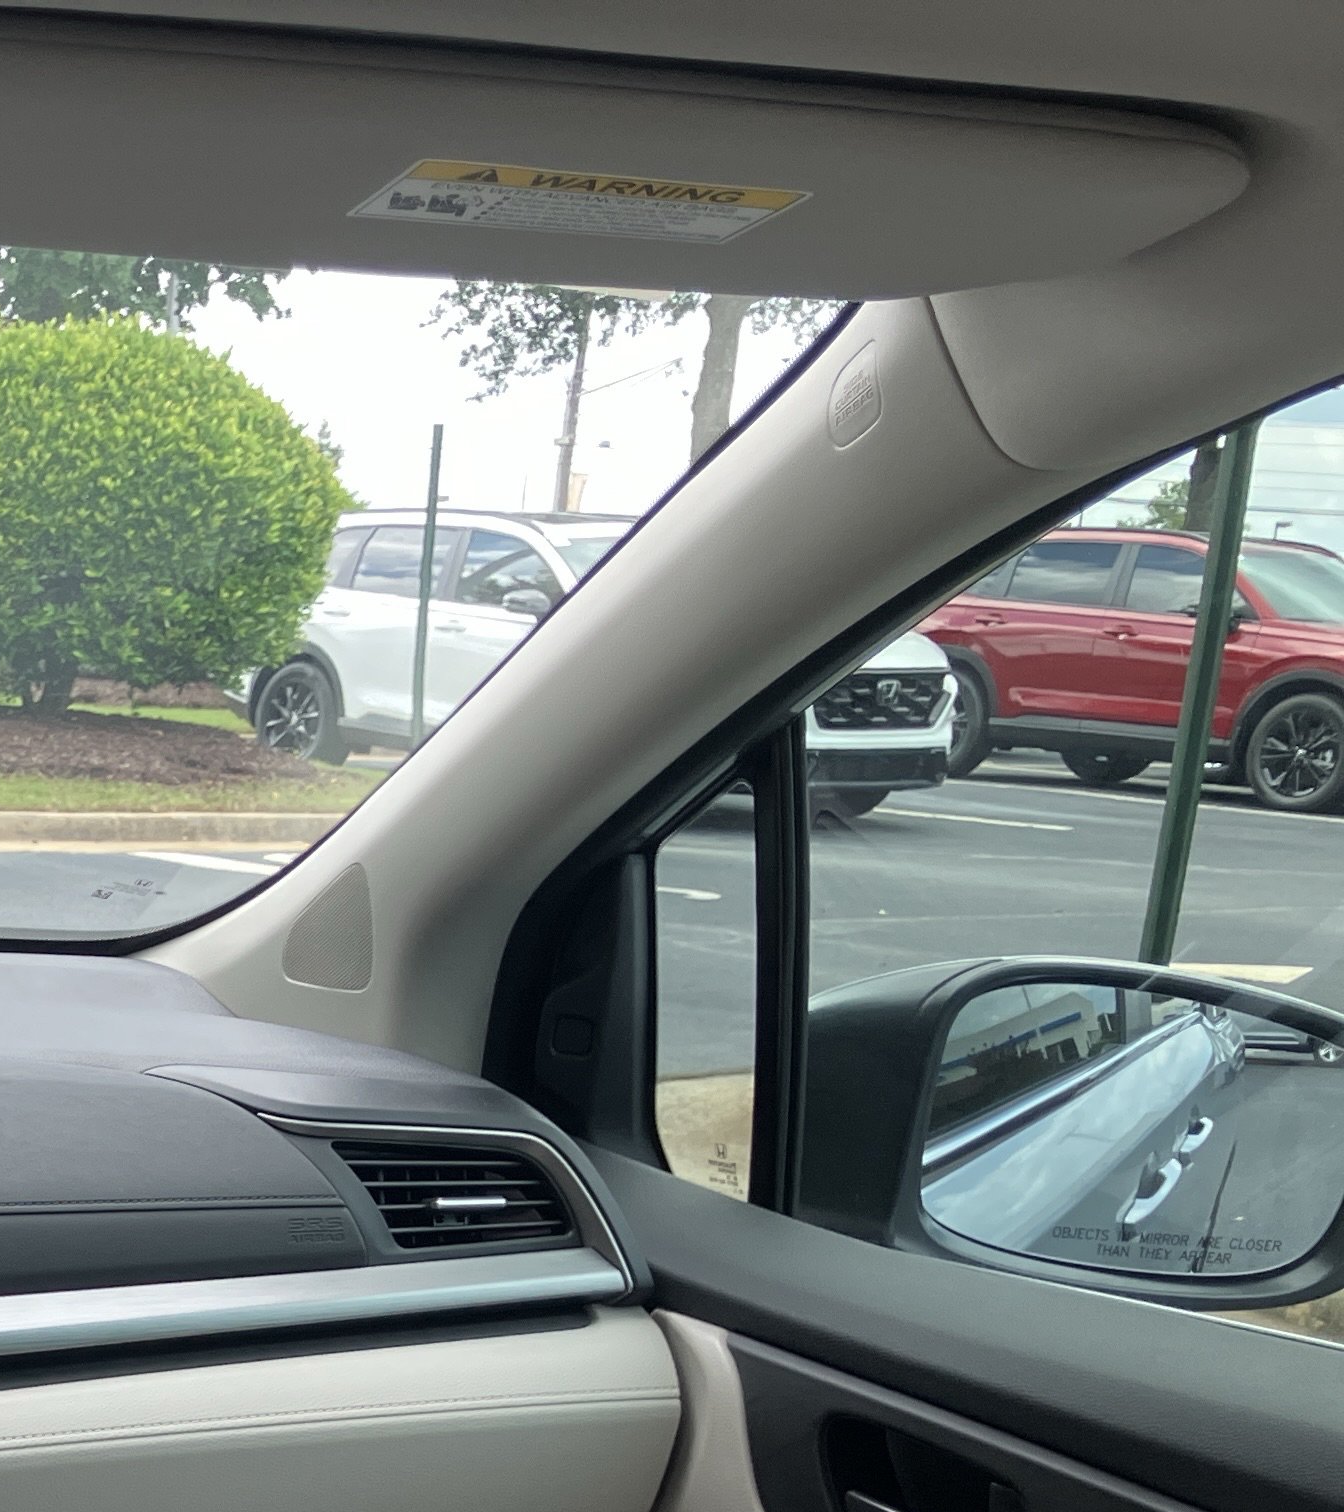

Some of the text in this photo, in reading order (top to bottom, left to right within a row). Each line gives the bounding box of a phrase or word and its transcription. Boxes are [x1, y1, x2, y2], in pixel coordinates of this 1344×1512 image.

[530, 173, 746, 203] WARNING
[287, 1216, 344, 1230] SRS
[1051, 1225, 1110, 1242] OBJECTS
[1138, 1231, 1190, 1247] MIRROR
[1196, 1235, 1221, 1249] ARE
[1229, 1237, 1283, 1252] CLOSER
[1096, 1243, 1130, 1258] THAN
[1137, 1246, 1173, 1260] THEY
